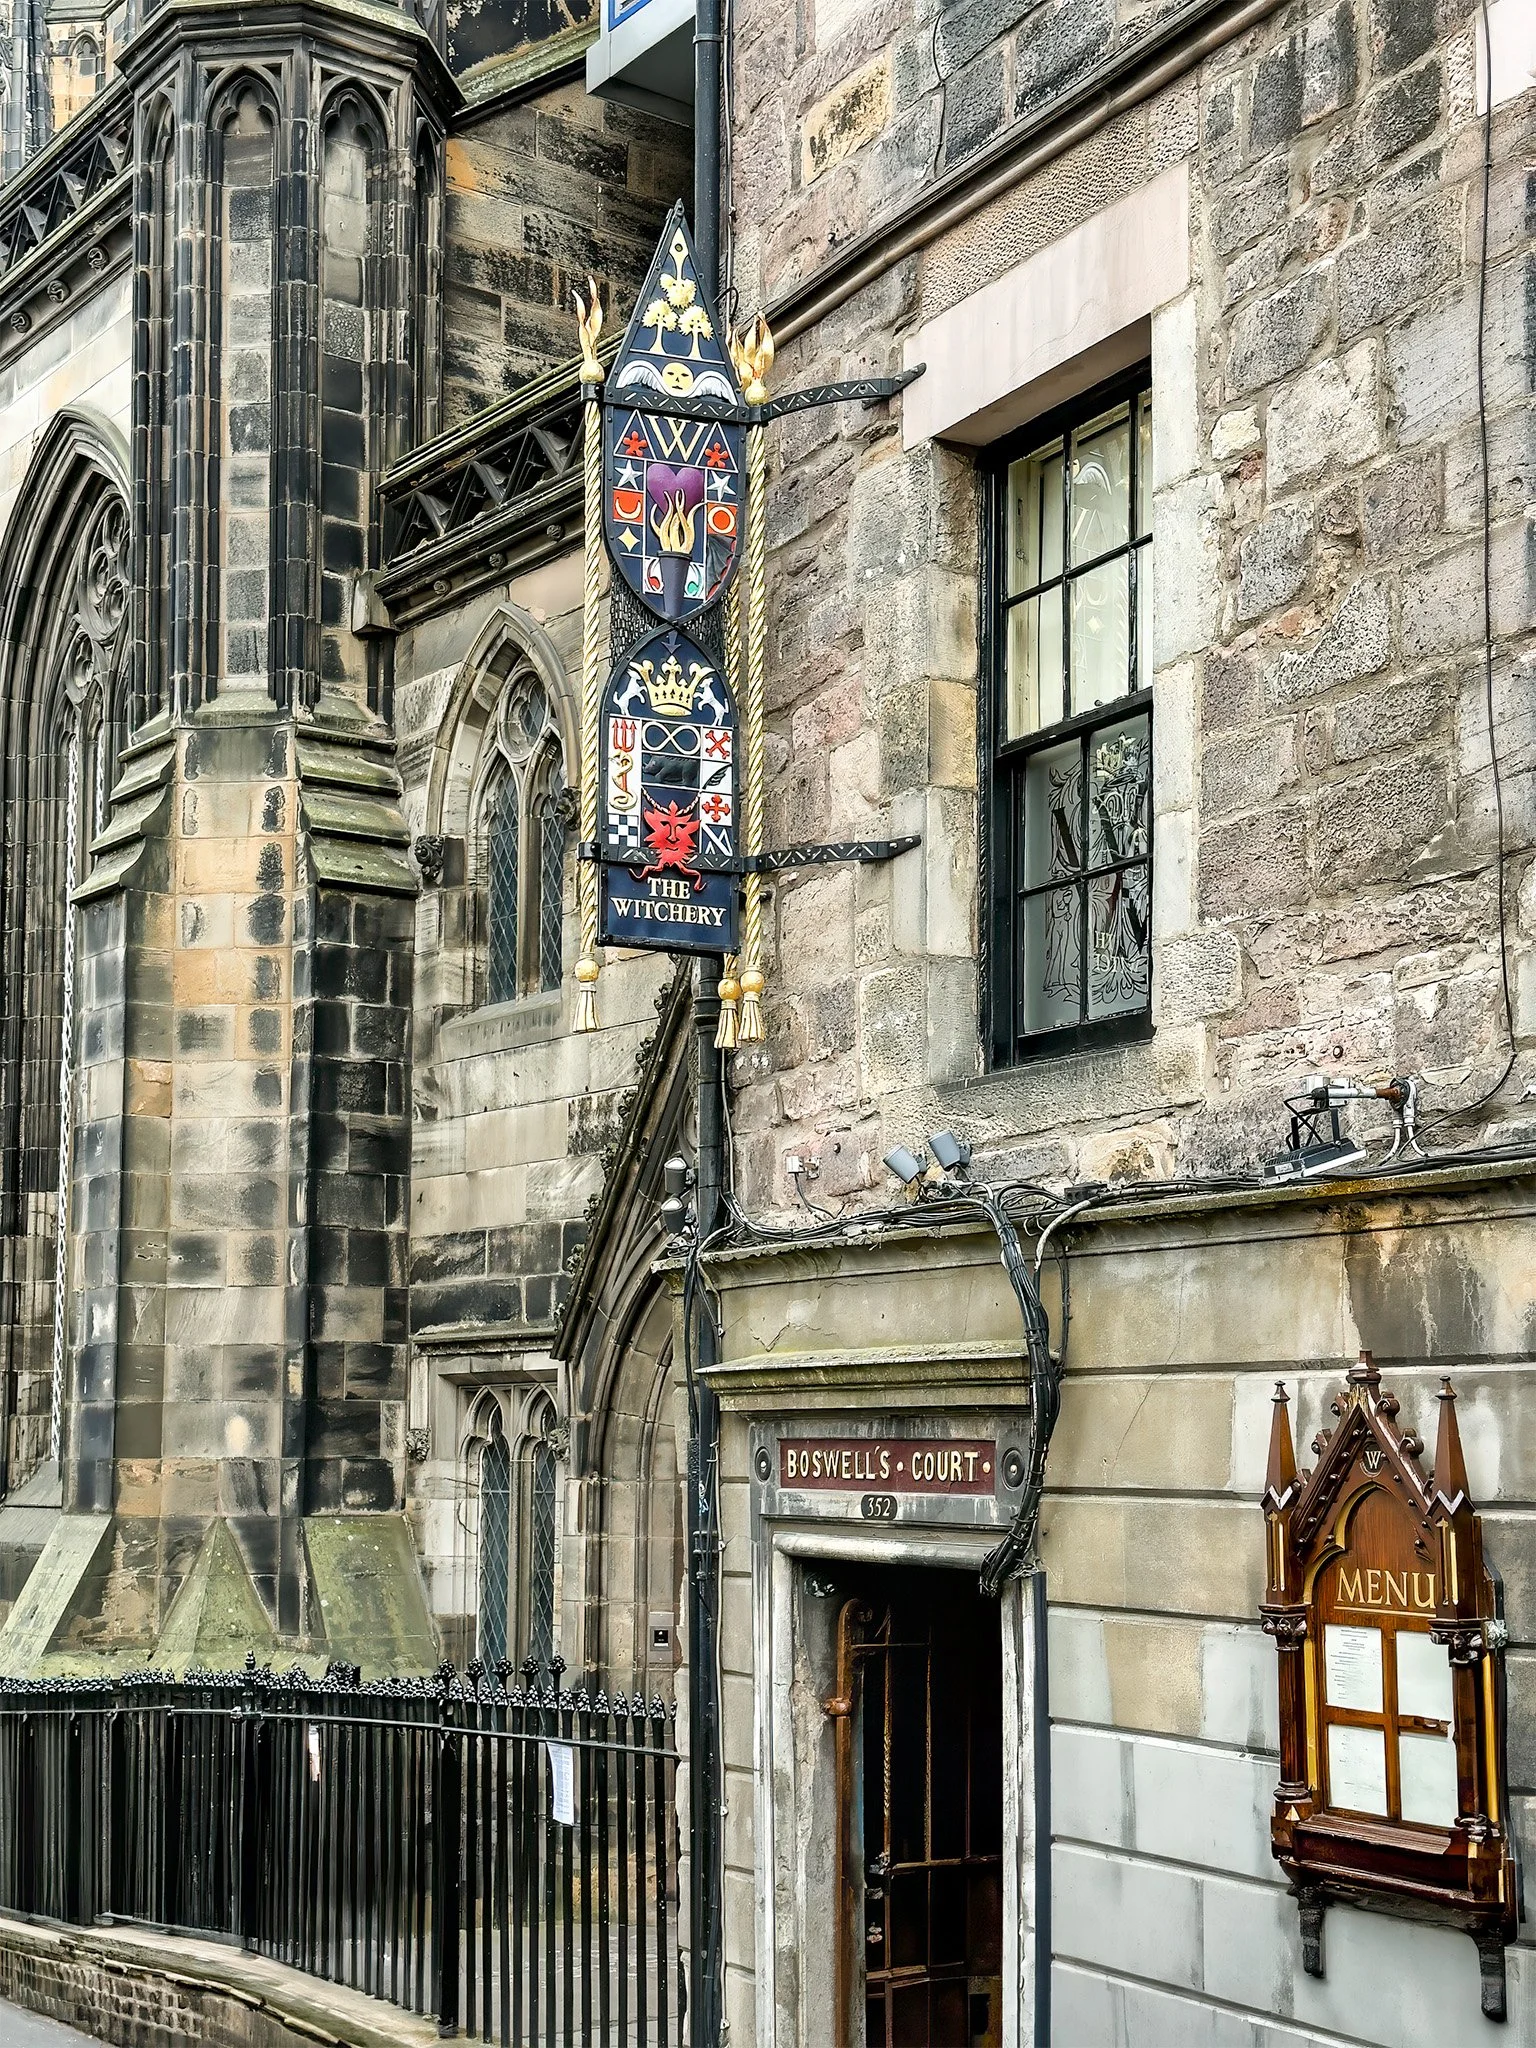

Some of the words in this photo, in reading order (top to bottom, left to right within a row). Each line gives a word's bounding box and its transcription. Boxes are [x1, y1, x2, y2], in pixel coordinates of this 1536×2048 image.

[645, 414, 709, 462] W
[647, 876, 691, 899] THE
[610, 897, 727, 927] WITCHERY
[786, 1446, 891, 1480] BOSWELL'S
[911, 1451, 979, 1482] COURT
[1365, 1450, 1382, 1469] W
[867, 1497, 891, 1517] 352
[1337, 1567, 1436, 1609] MENU
